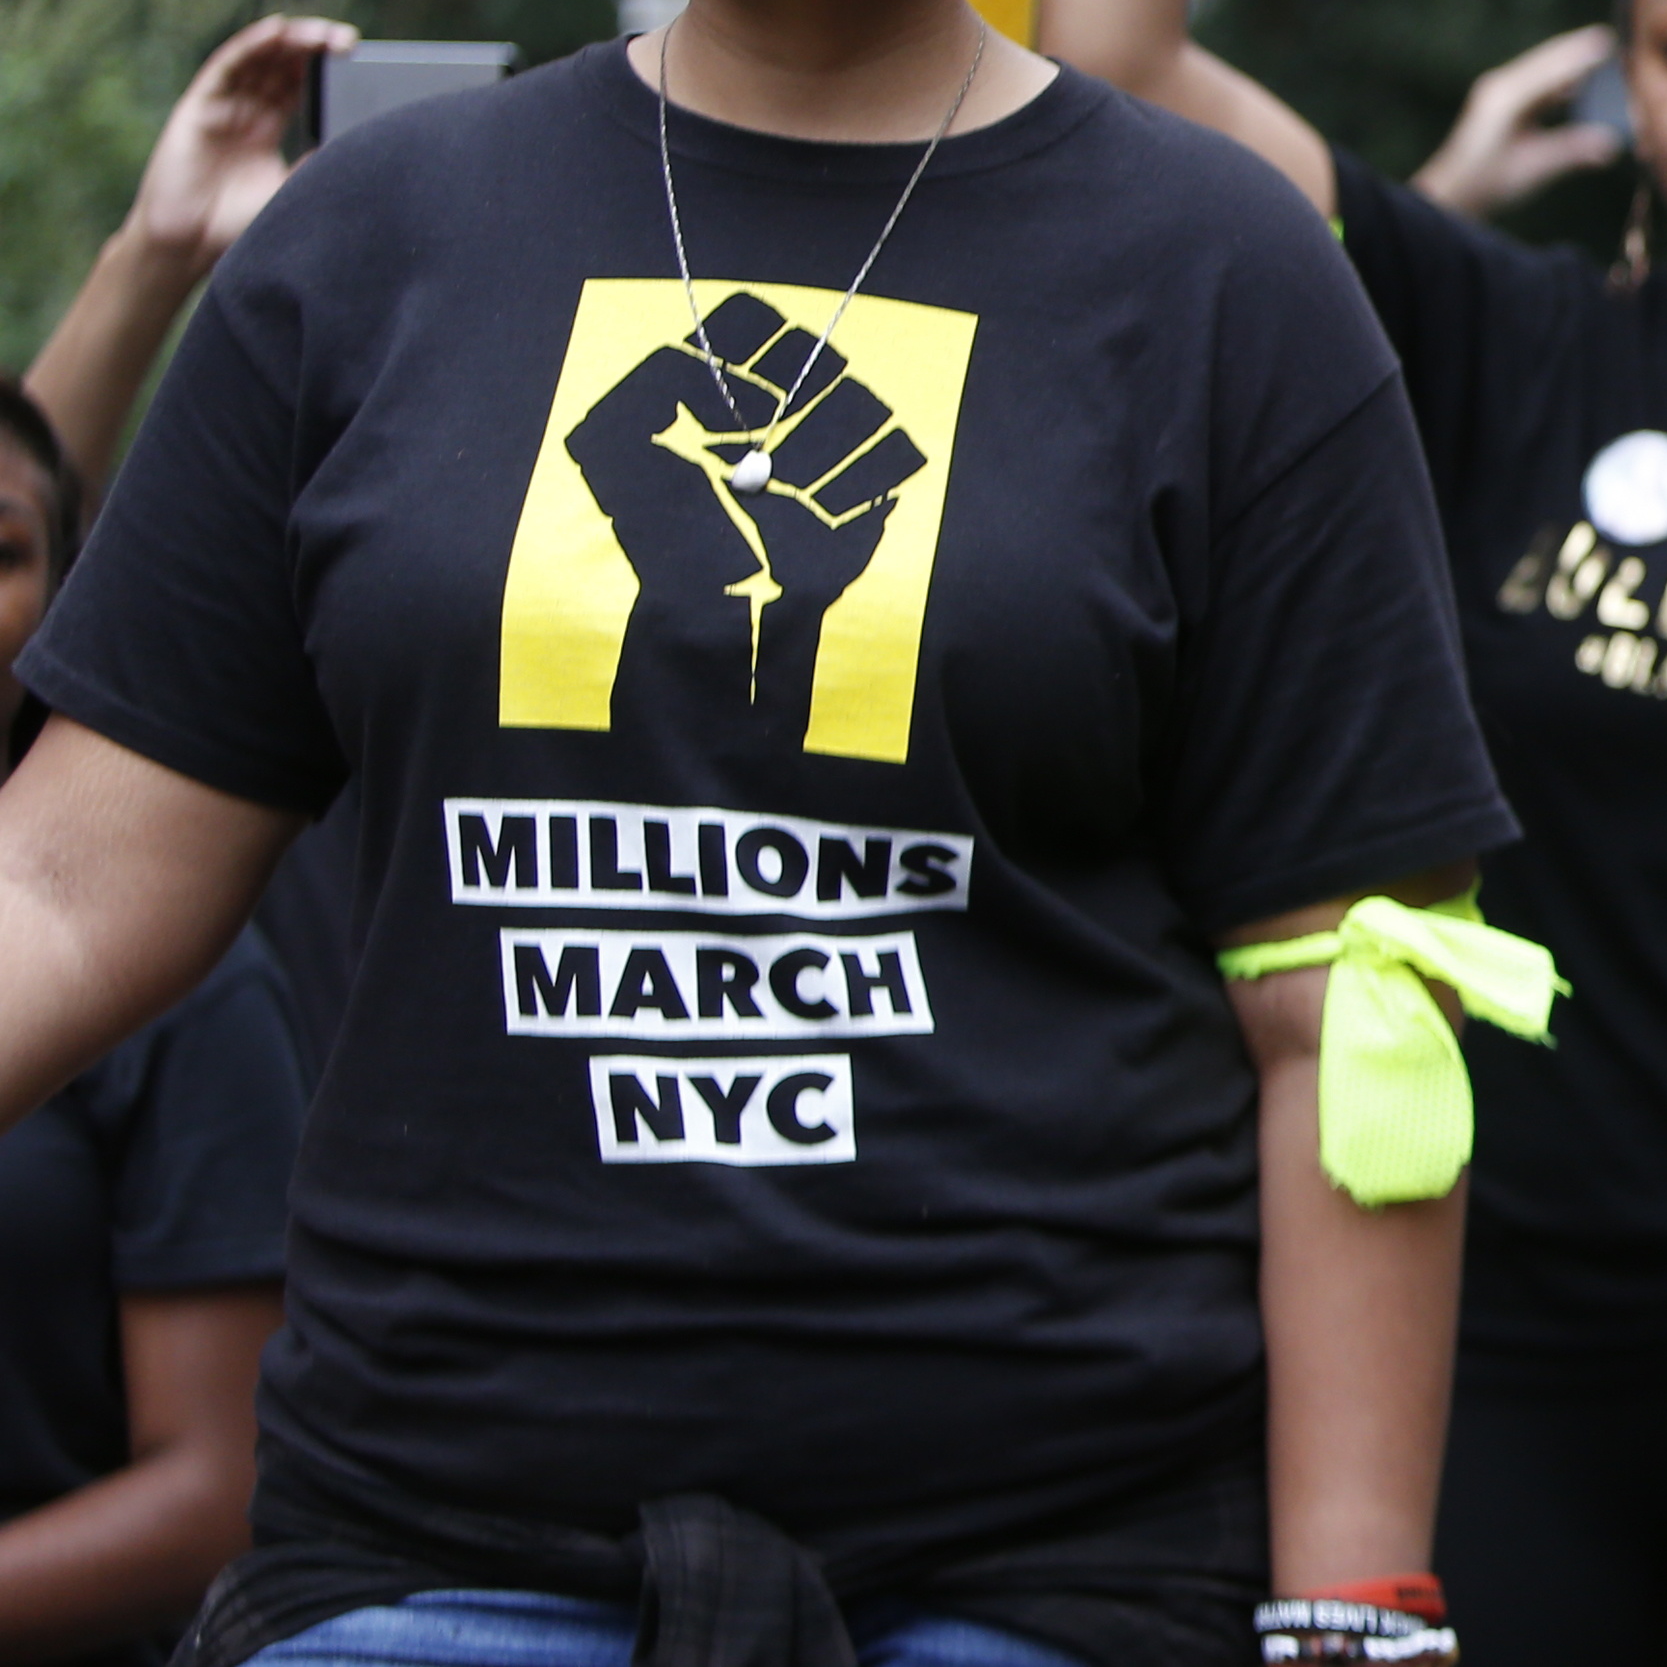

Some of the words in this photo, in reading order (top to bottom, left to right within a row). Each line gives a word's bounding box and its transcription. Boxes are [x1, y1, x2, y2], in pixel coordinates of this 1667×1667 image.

[457, 811, 960, 903] MILLIONS
[513, 945, 913, 1020] MARCH
[608, 1071, 838, 1145] NYC
